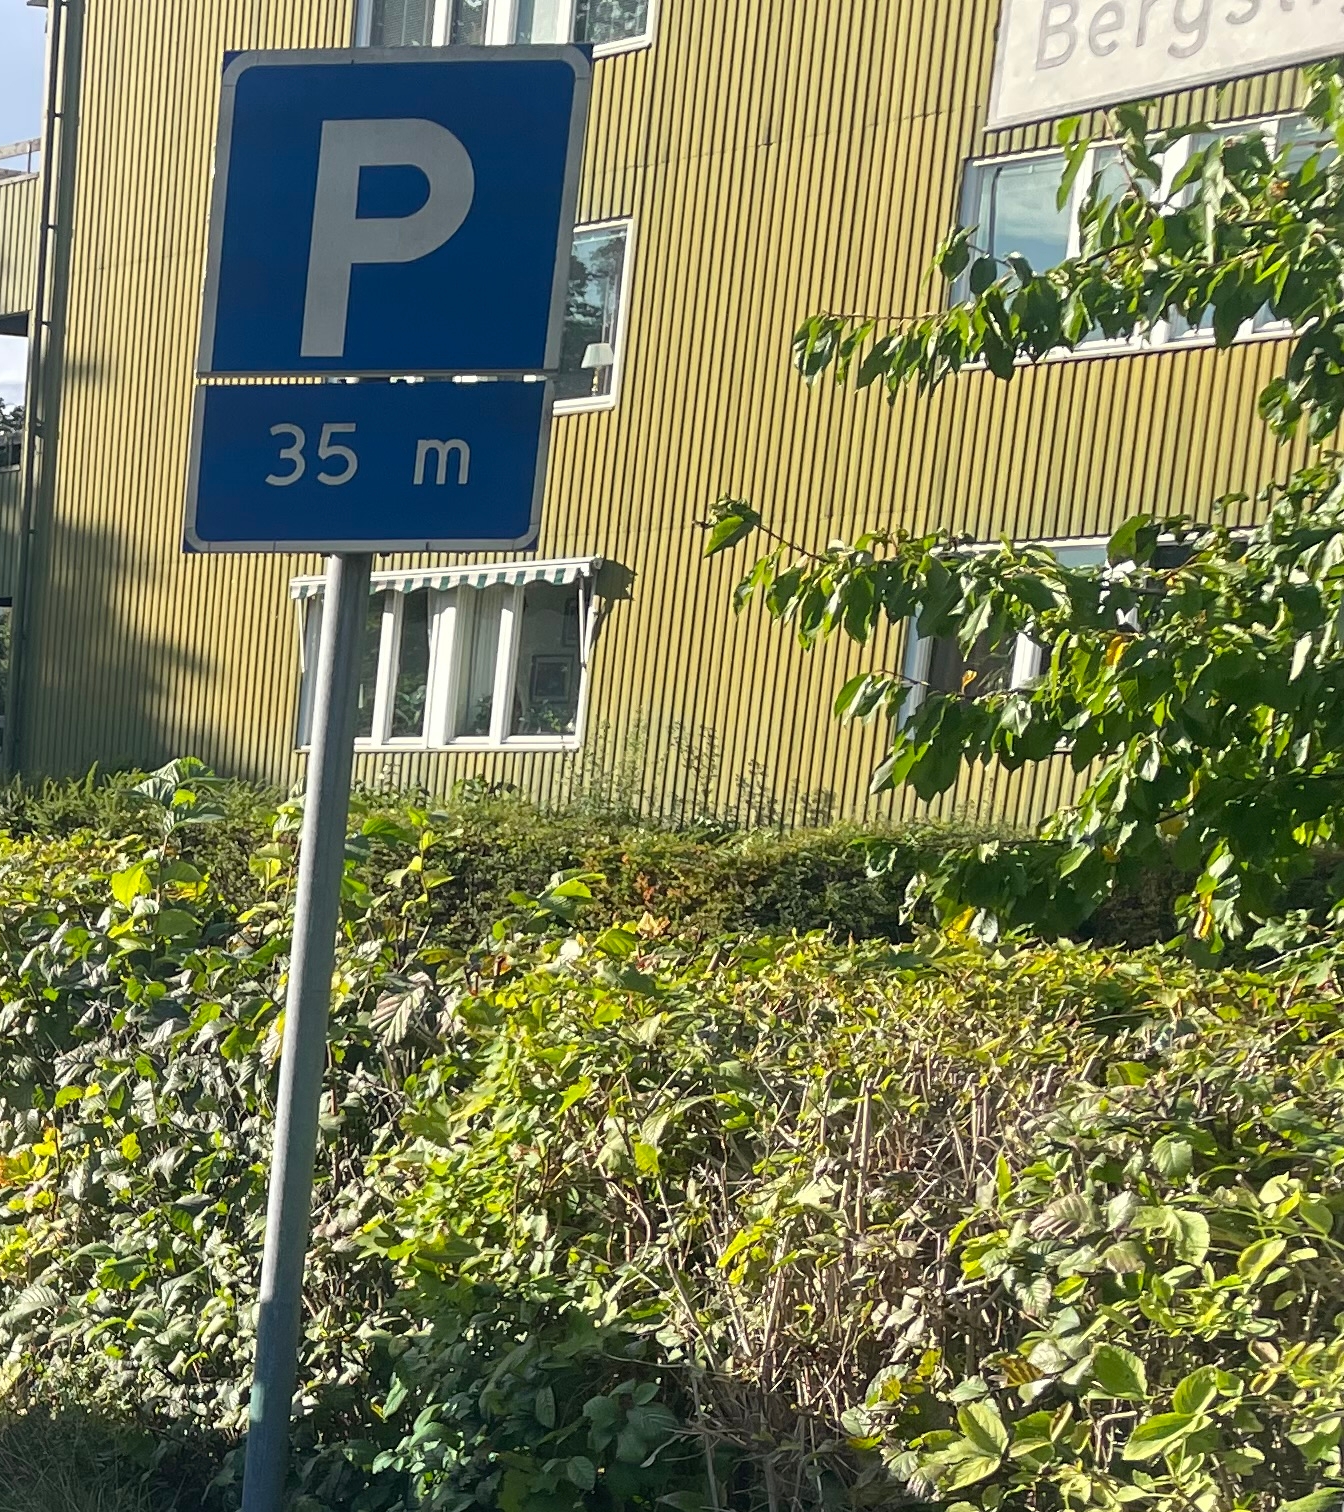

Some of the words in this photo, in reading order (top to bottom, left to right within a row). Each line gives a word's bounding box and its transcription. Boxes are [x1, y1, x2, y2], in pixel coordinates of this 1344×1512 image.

[299, 118, 475, 357] P
[264, 422, 359, 486] 35
[412, 437, 472, 486] m
